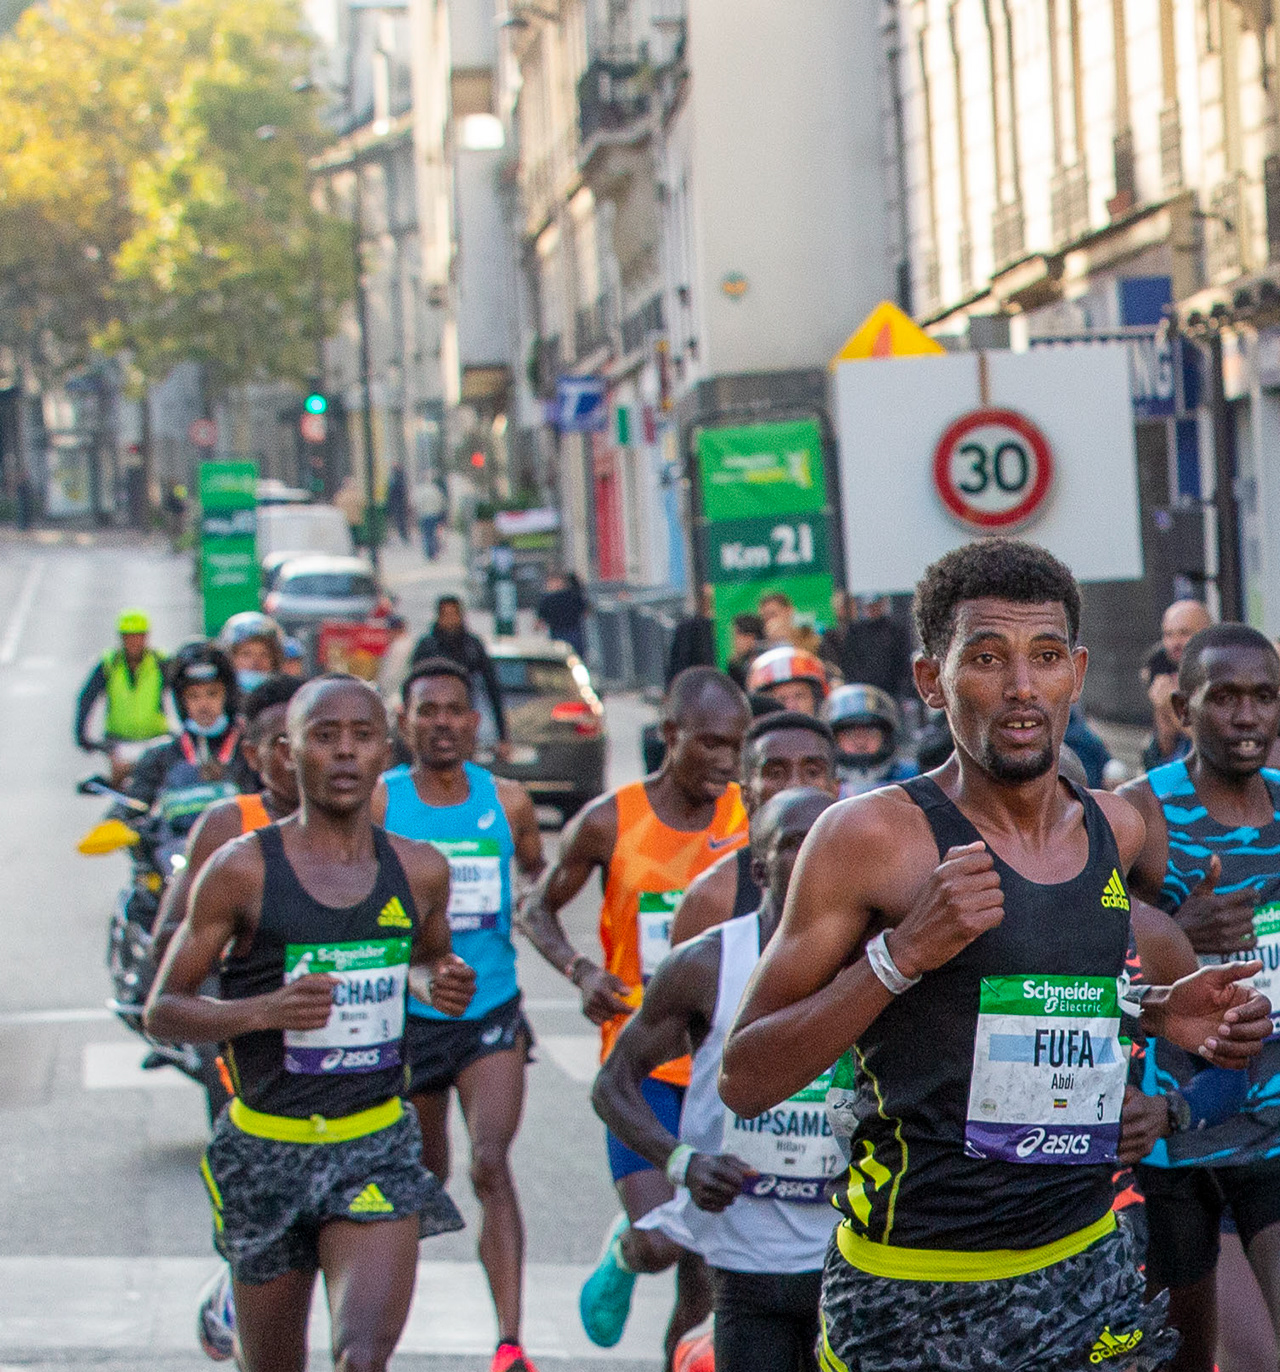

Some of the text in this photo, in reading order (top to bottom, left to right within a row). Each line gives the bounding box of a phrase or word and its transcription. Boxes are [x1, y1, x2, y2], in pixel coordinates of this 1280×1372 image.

[958, 441, 1029, 494] 30
[721, 523, 813, 570] Km 21
[1022, 980, 1104, 1000] Schneider
[1059, 1002, 1102, 1013] Electric
[1033, 1029, 1094, 1068] FUFA
[1051, 1073, 1075, 1090] Abdi
[1097, 1094, 1106, 1121] 5
[1042, 1134, 1091, 1154] asics
[1089, 1329, 1143, 1364] adidas
